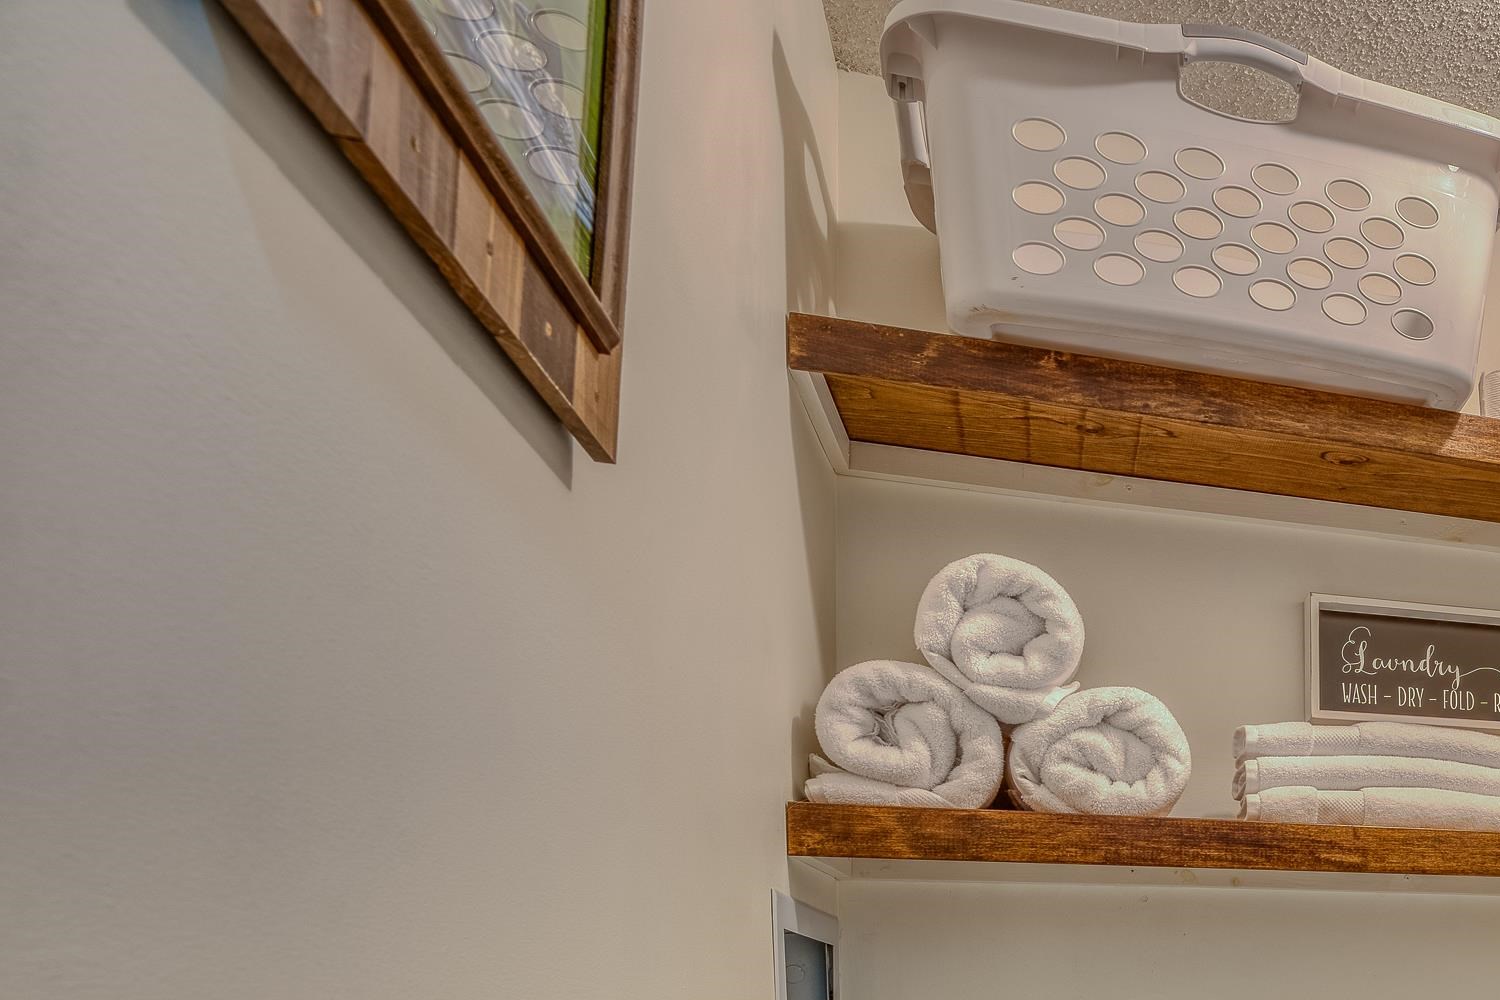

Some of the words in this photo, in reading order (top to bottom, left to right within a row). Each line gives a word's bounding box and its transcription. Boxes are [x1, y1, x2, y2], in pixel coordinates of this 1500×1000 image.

[1342, 682, 1377, 705] WASH
[1398, 686, 1424, 708] DRY
[1443, 689, 1475, 711] FOLD
